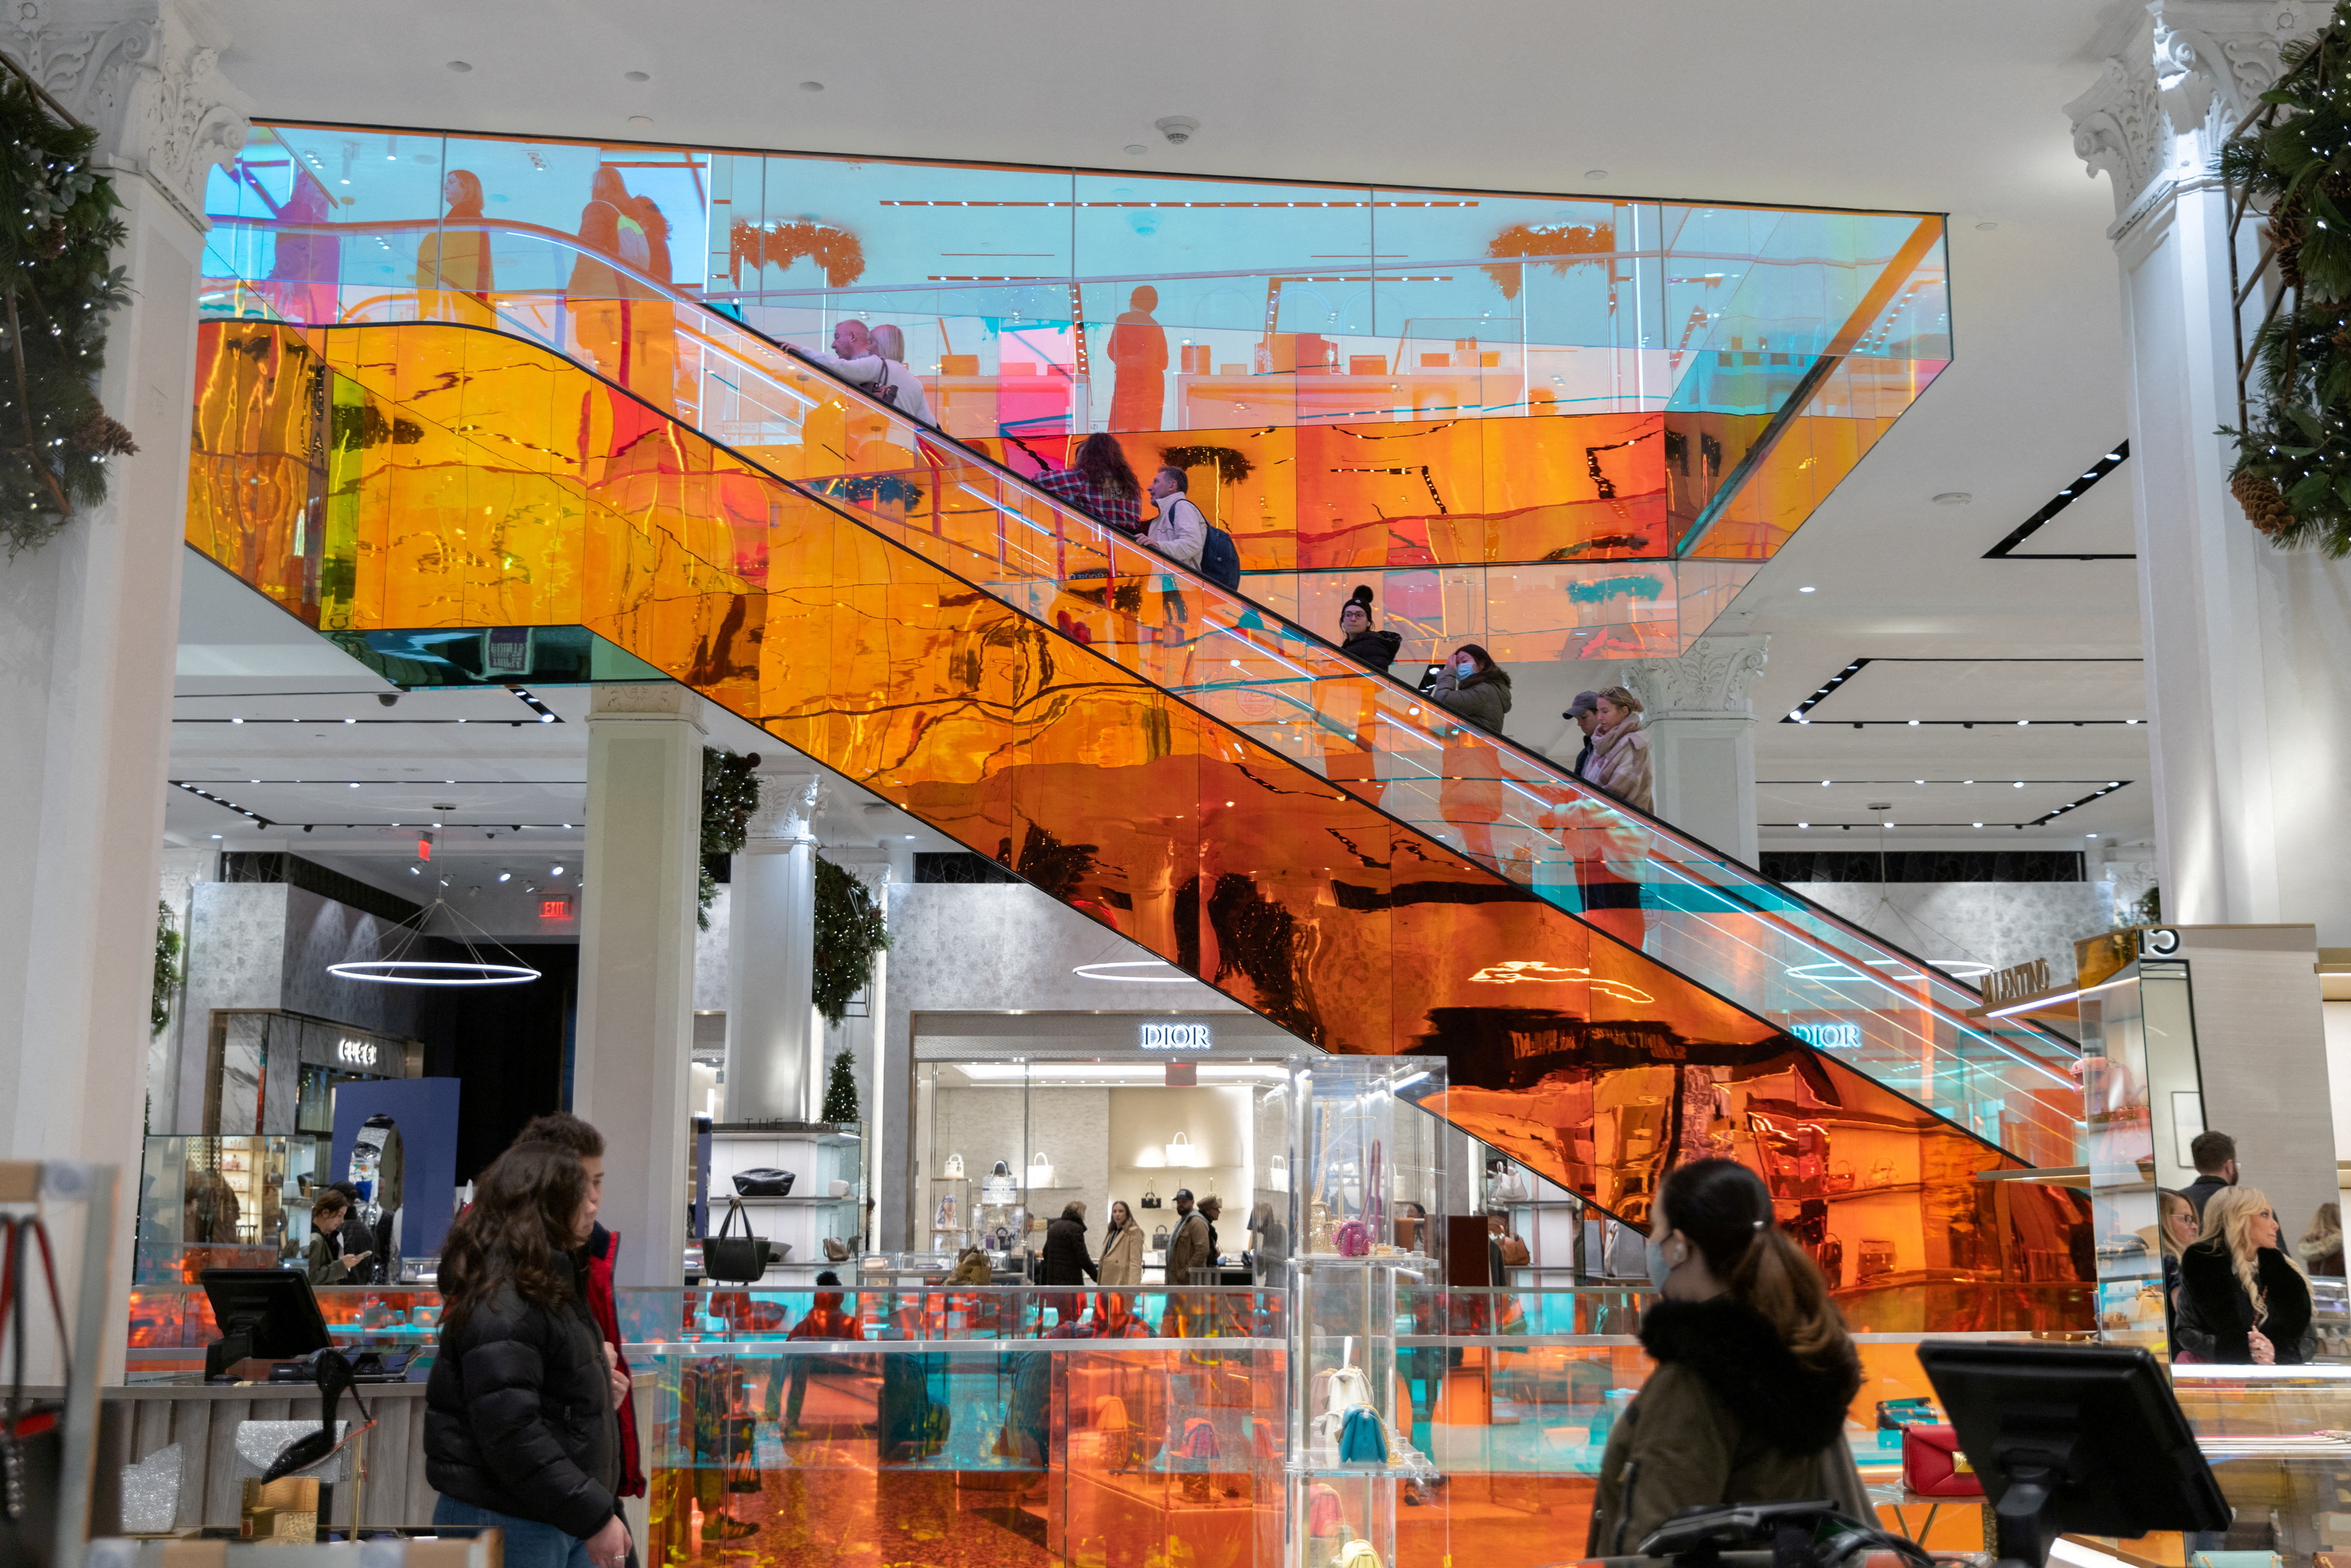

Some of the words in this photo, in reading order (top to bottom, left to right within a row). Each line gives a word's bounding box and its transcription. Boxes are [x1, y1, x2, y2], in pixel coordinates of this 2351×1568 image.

[544, 901, 565, 915] EXIT
[1979, 957, 2050, 1005] VALENTINO
[1142, 1025, 1210, 1047] DIOR
[1790, 1025, 1861, 1047] DIOR
[744, 1117, 783, 1130] THE
[801, 1117, 842, 1130] ROW
